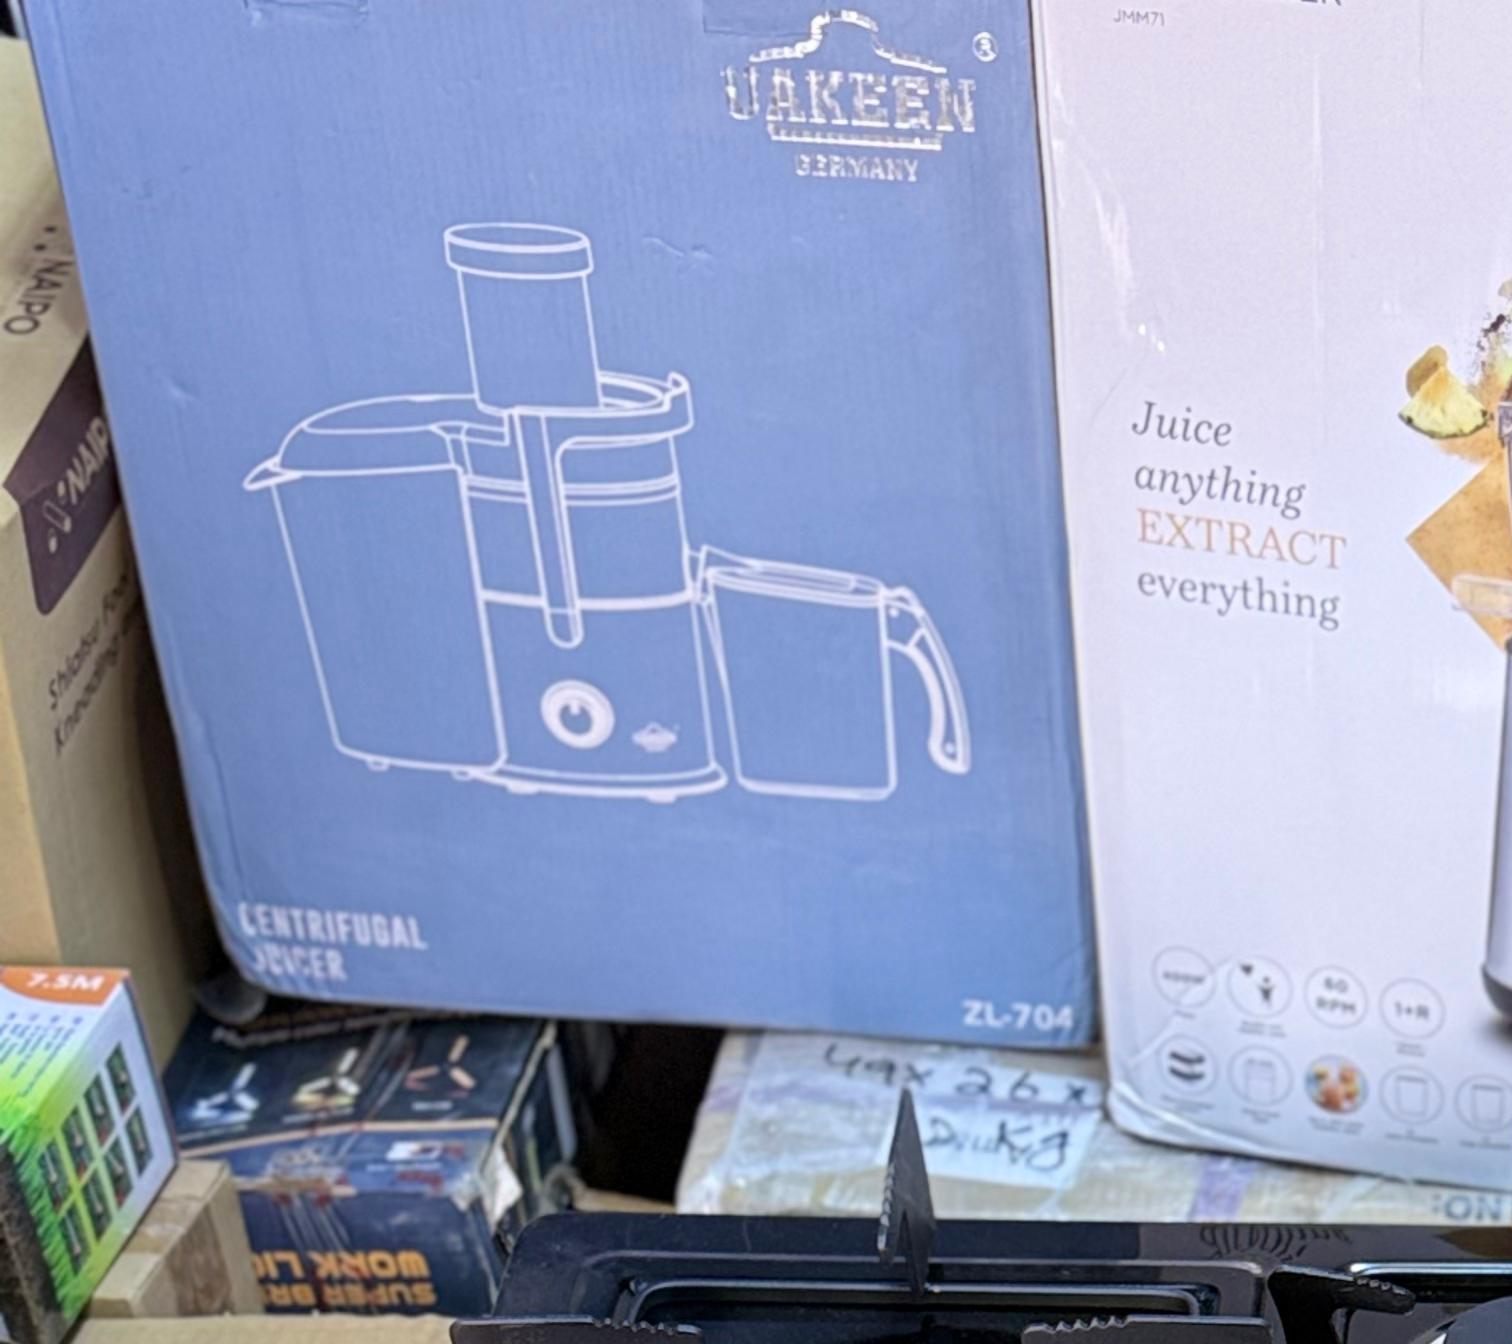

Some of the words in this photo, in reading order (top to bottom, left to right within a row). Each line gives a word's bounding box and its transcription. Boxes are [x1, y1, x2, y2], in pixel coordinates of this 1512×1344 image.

[1113, 9, 1165, 26] JMM71
[794, 154, 919, 183] GERMANY
[3, 256, 73, 335] NAIPO
[1132, 400, 1232, 446] Juice
[64, 416, 110, 505] NAIP
[1134, 464, 1306, 521] anything
[1137, 508, 1347, 570] EXTRACT
[1137, 572, 1341, 632] everything
[238, 902, 428, 950] CENTRIFUGAL
[962, 998, 1073, 1031] ZL-704
[1316, 997, 1357, 1015] RPM
[309, 1249, 431, 1280] WORK
[322, 1281, 437, 1307] SUPER
